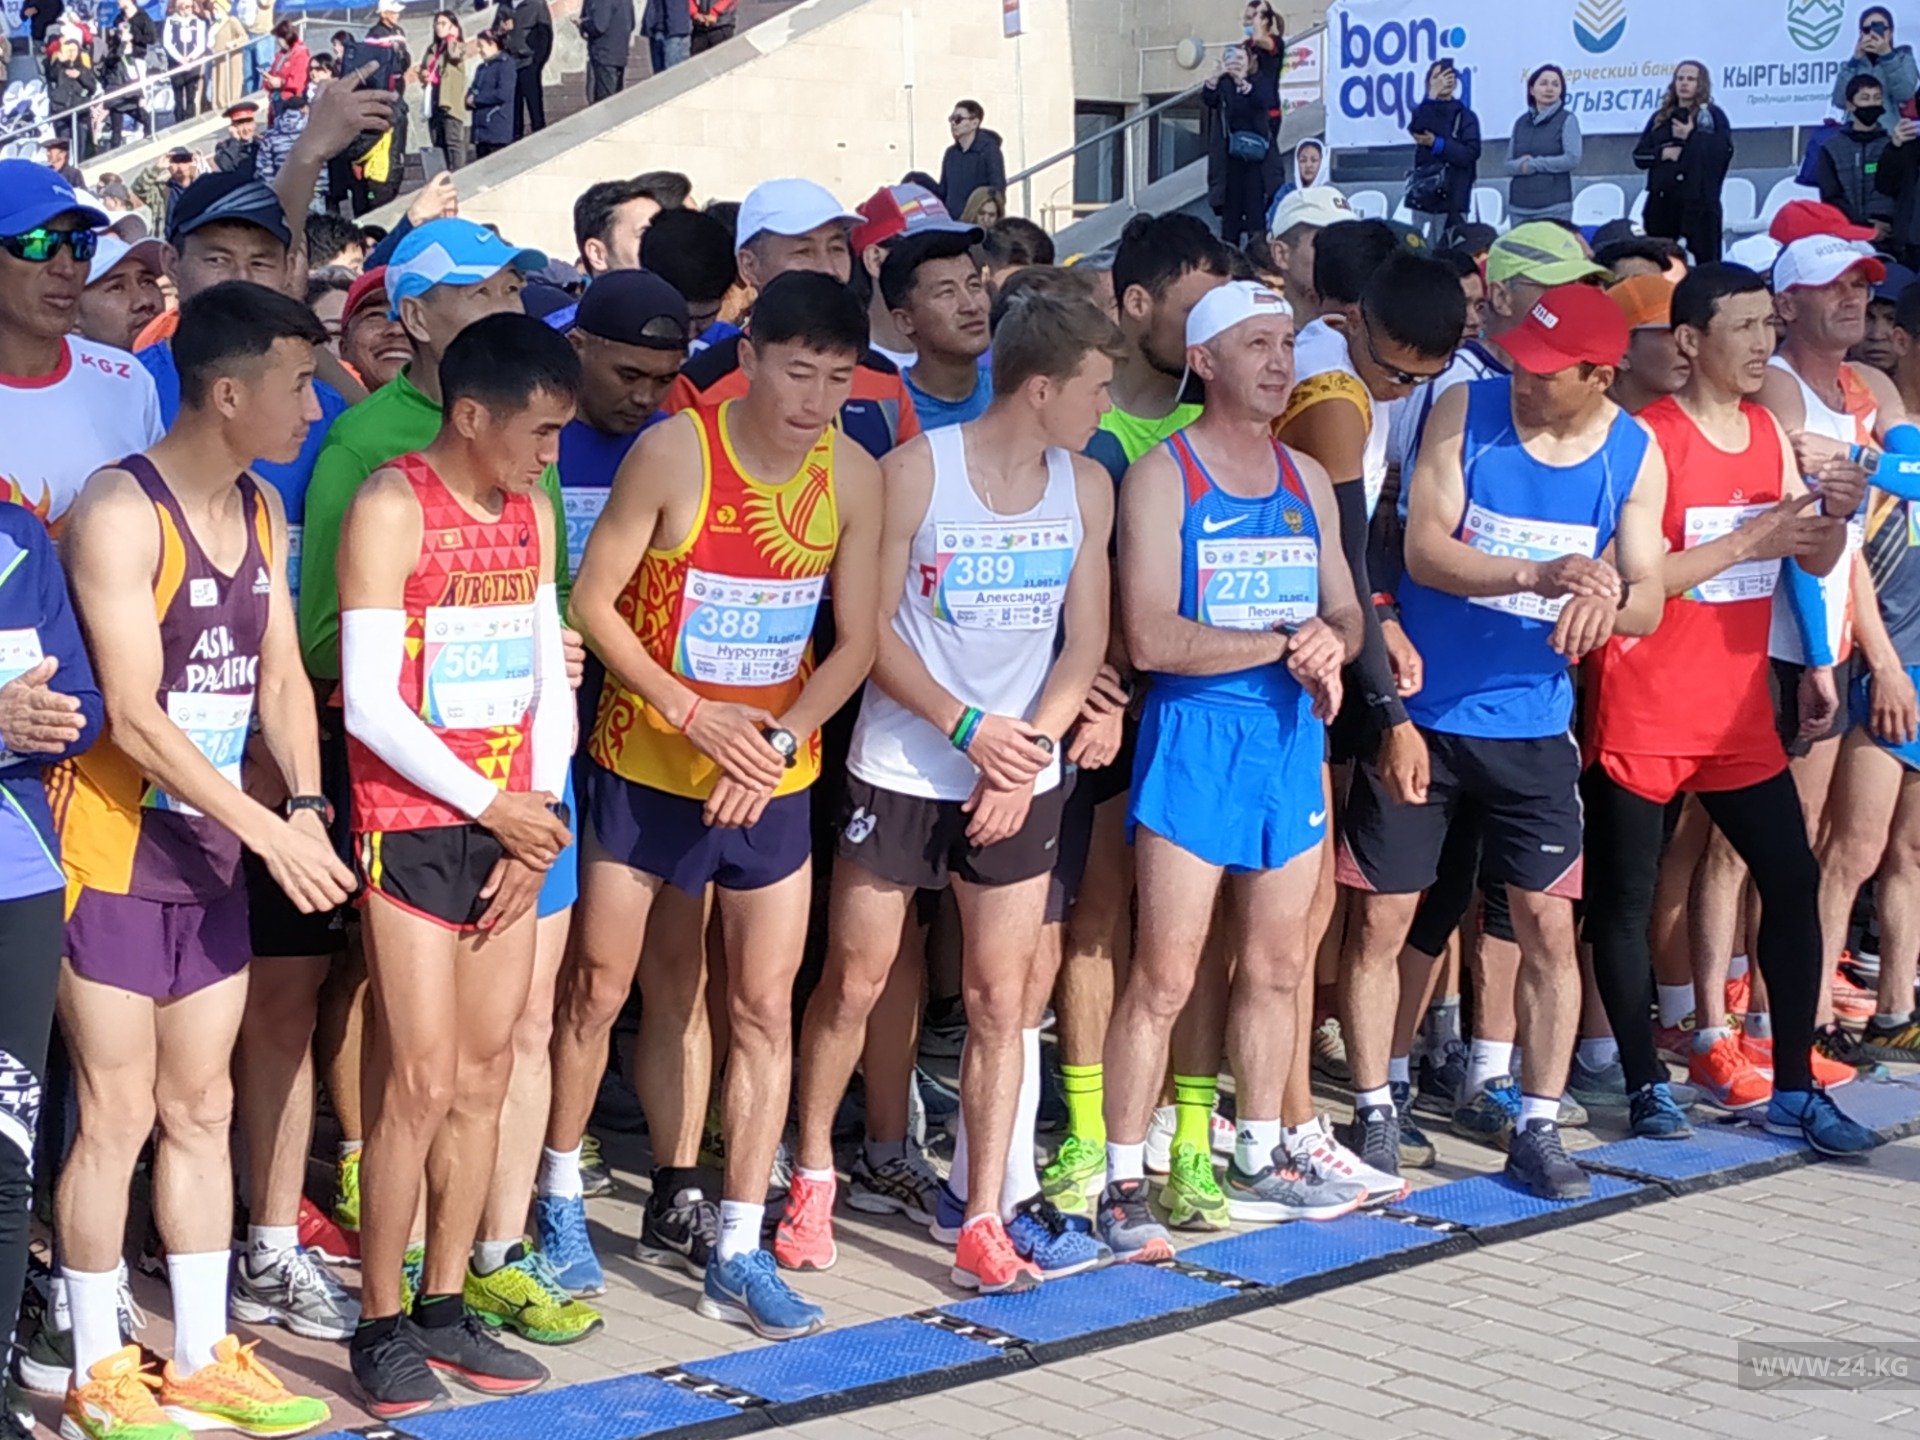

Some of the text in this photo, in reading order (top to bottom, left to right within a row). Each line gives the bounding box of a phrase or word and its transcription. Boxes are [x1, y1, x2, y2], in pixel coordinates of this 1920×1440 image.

[1340, 11, 1436, 69] bon
[81, 353, 130, 379] KGZ
[955, 555, 1015, 585] 389
[1215, 570, 1271, 600] 273
[975, 592, 1051, 604] Александр
[1247, 606, 1296, 618] Леонид
[699, 606, 761, 639] 388
[443, 642, 500, 678] 564
[717, 644, 790, 661] Нурсултан
